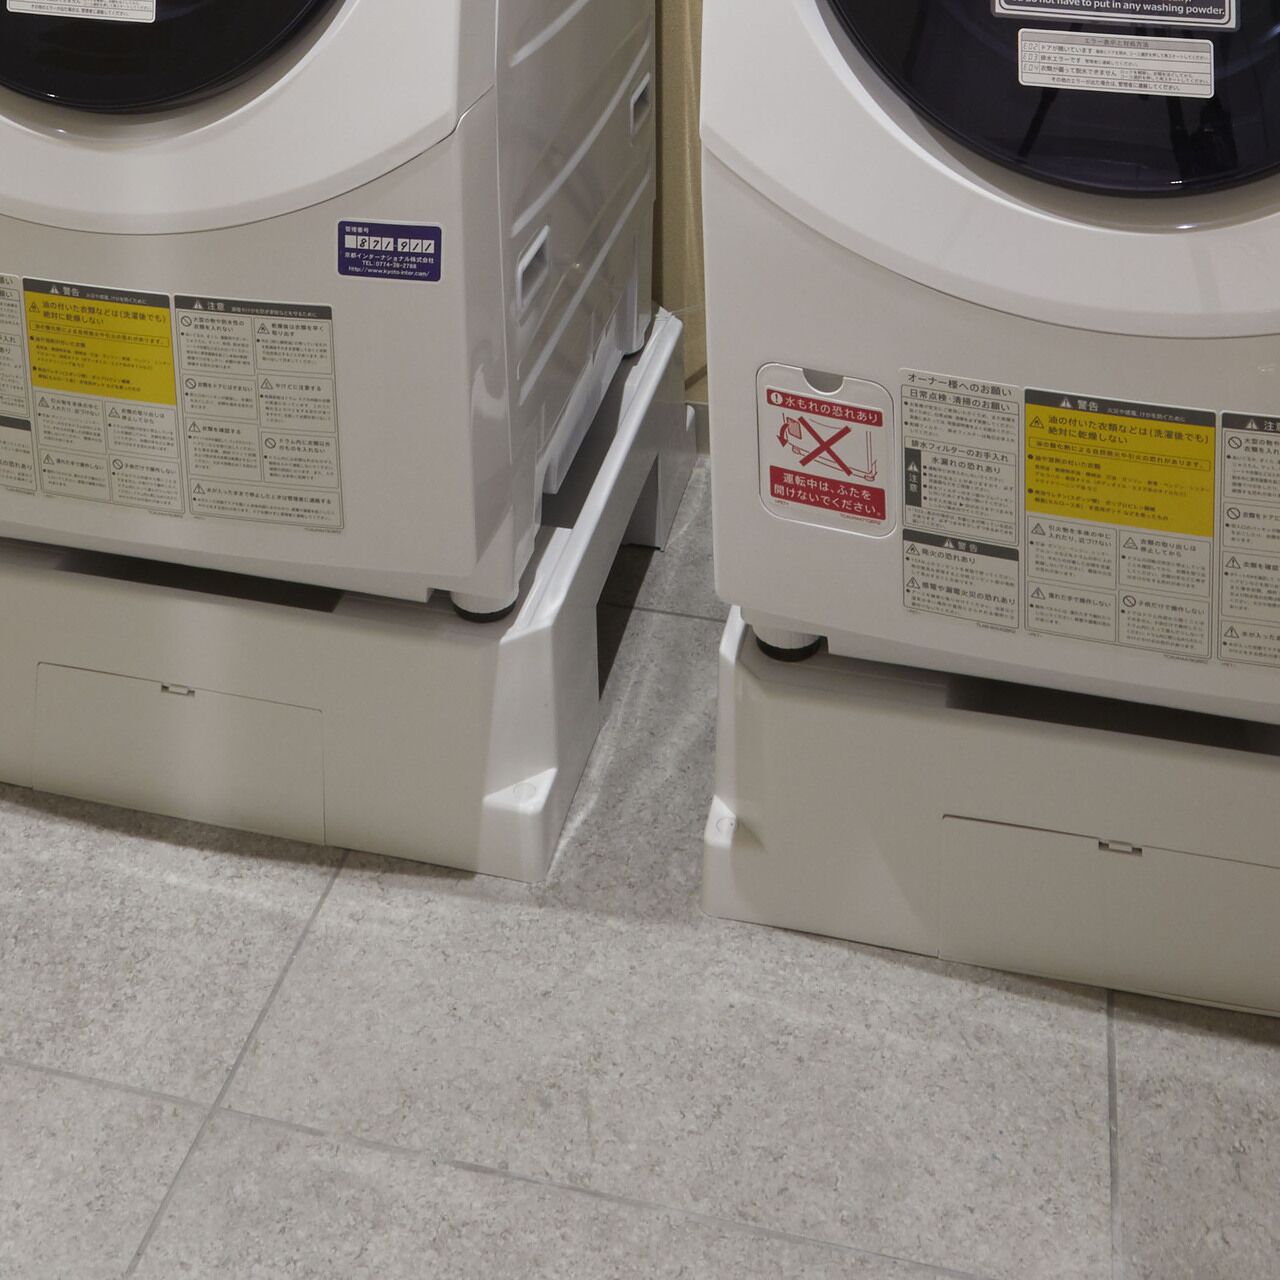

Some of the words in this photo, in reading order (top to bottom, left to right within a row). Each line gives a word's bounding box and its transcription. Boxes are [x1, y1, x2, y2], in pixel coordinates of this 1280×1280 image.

[1082, 0, 1092, 7] to
[1094, 0, 1109, 9] put
[1123, 3, 1141, 11] any
[1143, 3, 1183, 13] washing
[1186, 5, 1225, 15] powder.
[908, 374, 1012, 396] オーナー様へのお願い
[785, 397, 878, 423] 水もれの恐れあり
[1078, 399, 1098, 411] 警告
[1048, 426, 1128, 444] 絶対に乾燥しない
[931, 457, 1001, 474] 水漏れの恐れあり
[783, 472, 872, 500] 運転中は、ふたを
[774, 484, 881, 516] 開けないでください。
